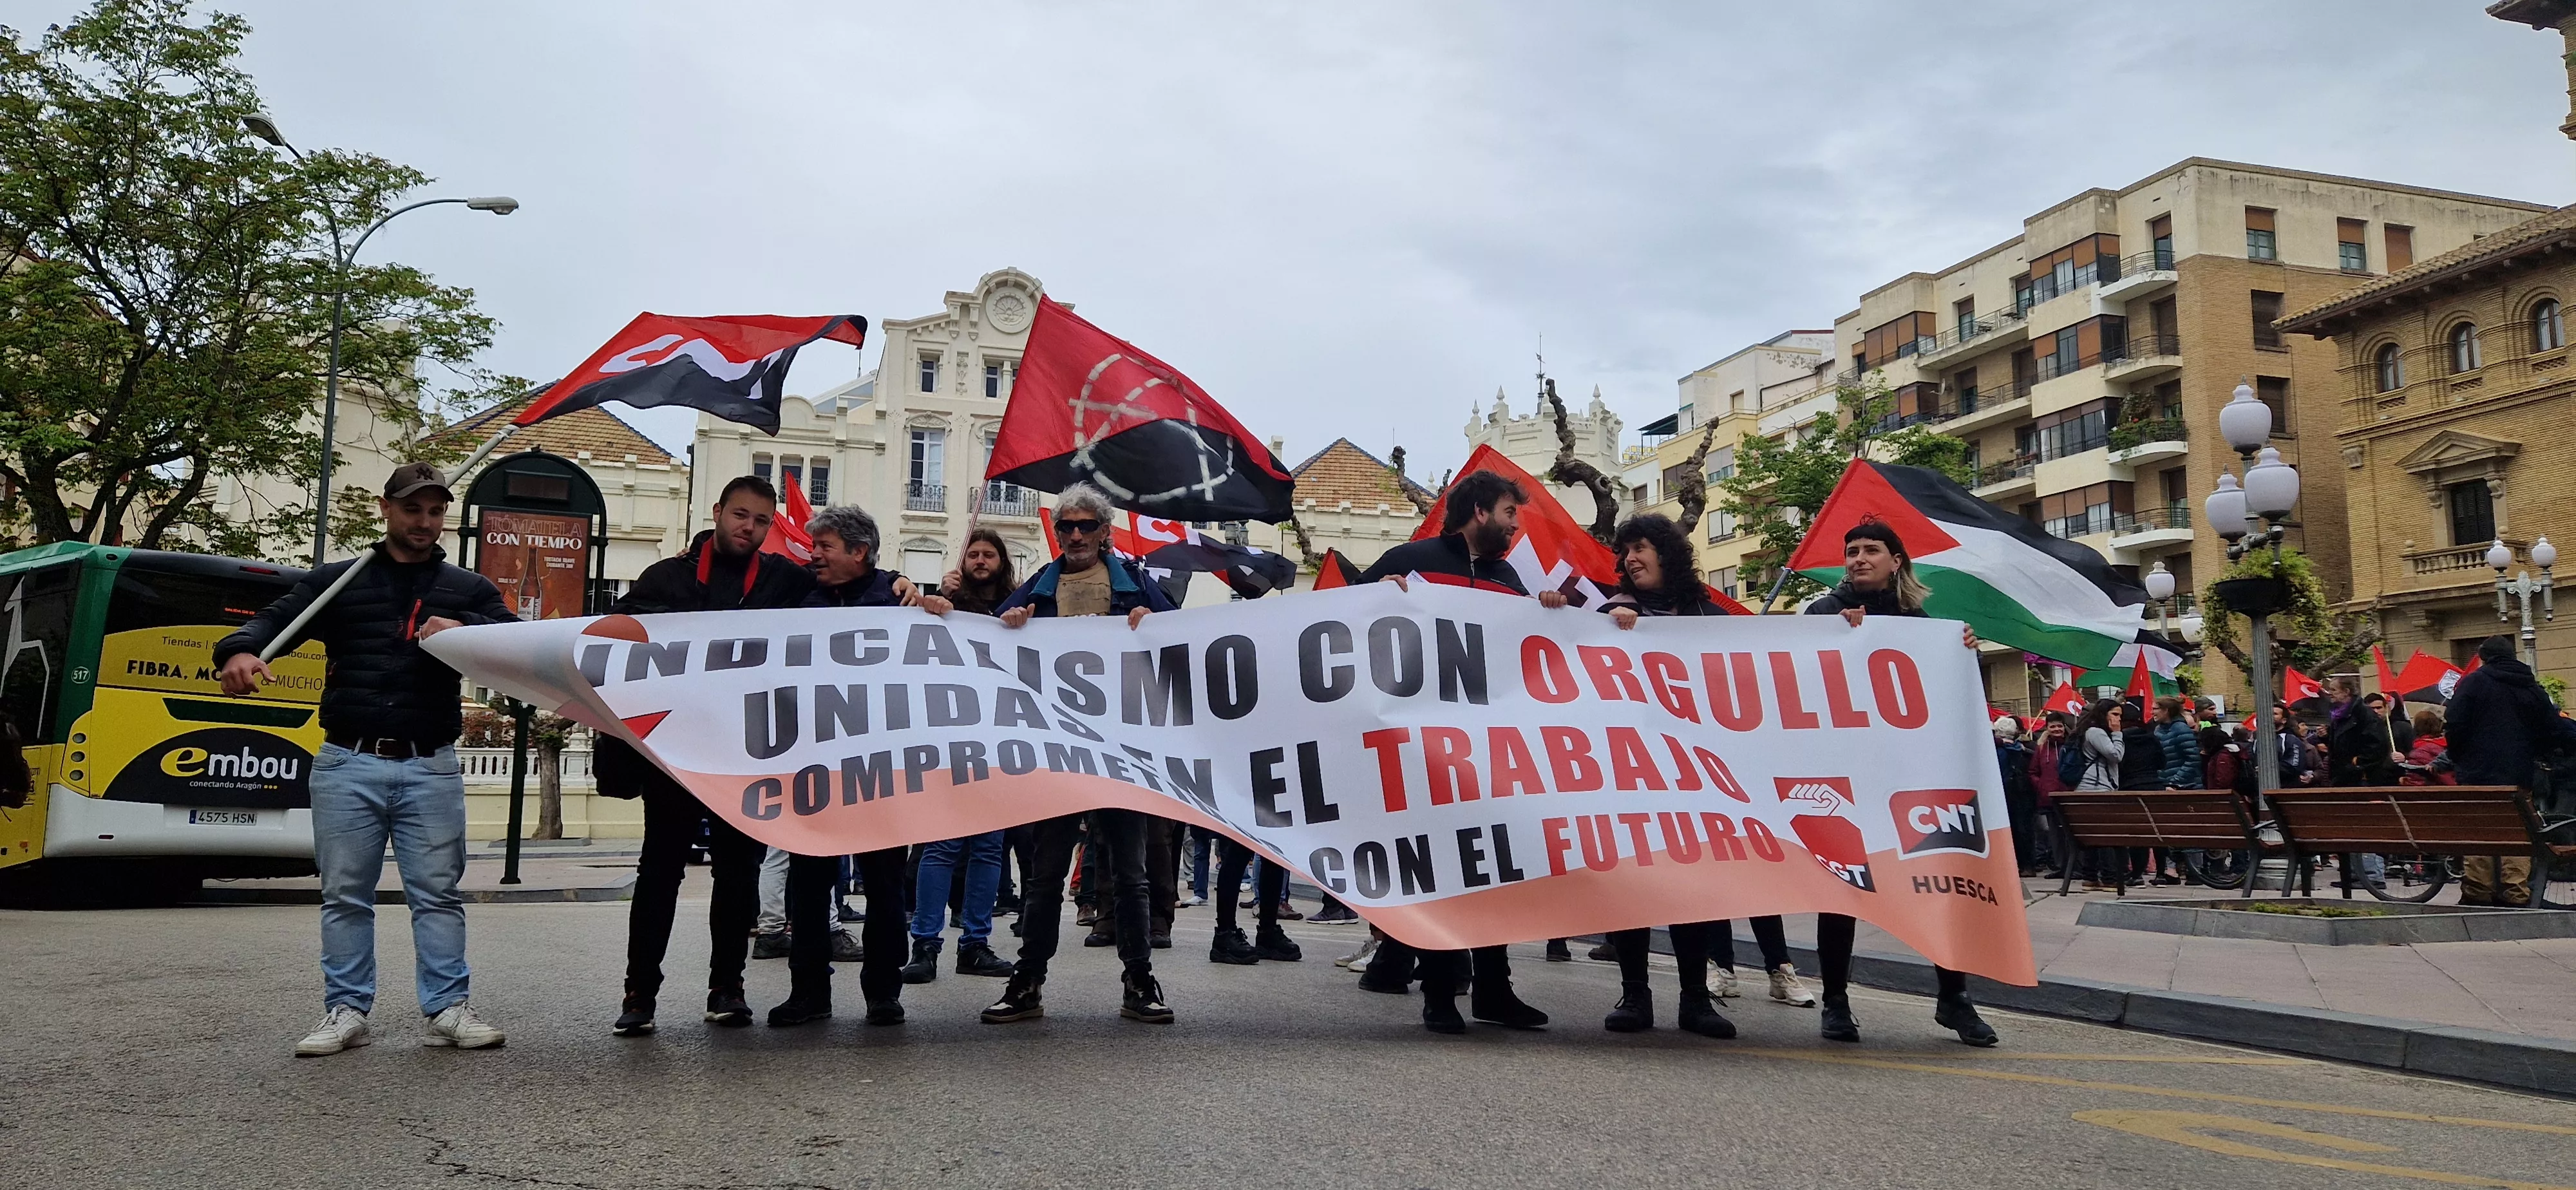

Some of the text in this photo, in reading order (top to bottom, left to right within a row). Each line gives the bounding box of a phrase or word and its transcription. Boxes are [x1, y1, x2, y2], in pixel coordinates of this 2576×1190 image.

[486, 532, 583, 550] CON TIEMPO
[162, 636, 202, 648] Tiendas
[73, 670, 88, 680] 517
[126, 659, 188, 681] FIBRA,
[275, 674, 323, 691] MUCHO
[580, 616, 1929, 731] INDICALISMO CON ORGULLO
[160, 746, 298, 780] embou
[1249, 740, 1340, 828] EL
[1363, 726, 1750, 813] TRABAJO
[236, 781, 262, 791] Aragón
[198, 812, 255, 824] 4575 HSN
[1908, 803, 1976, 836] CNT
[1309, 834, 1436, 900] CON
[1455, 824, 1524, 888] EL
[1542, 811, 1785, 877] FUTURO
[1815, 854, 1866, 887] CGT
[1911, 875, 1999, 907] HUESCA
